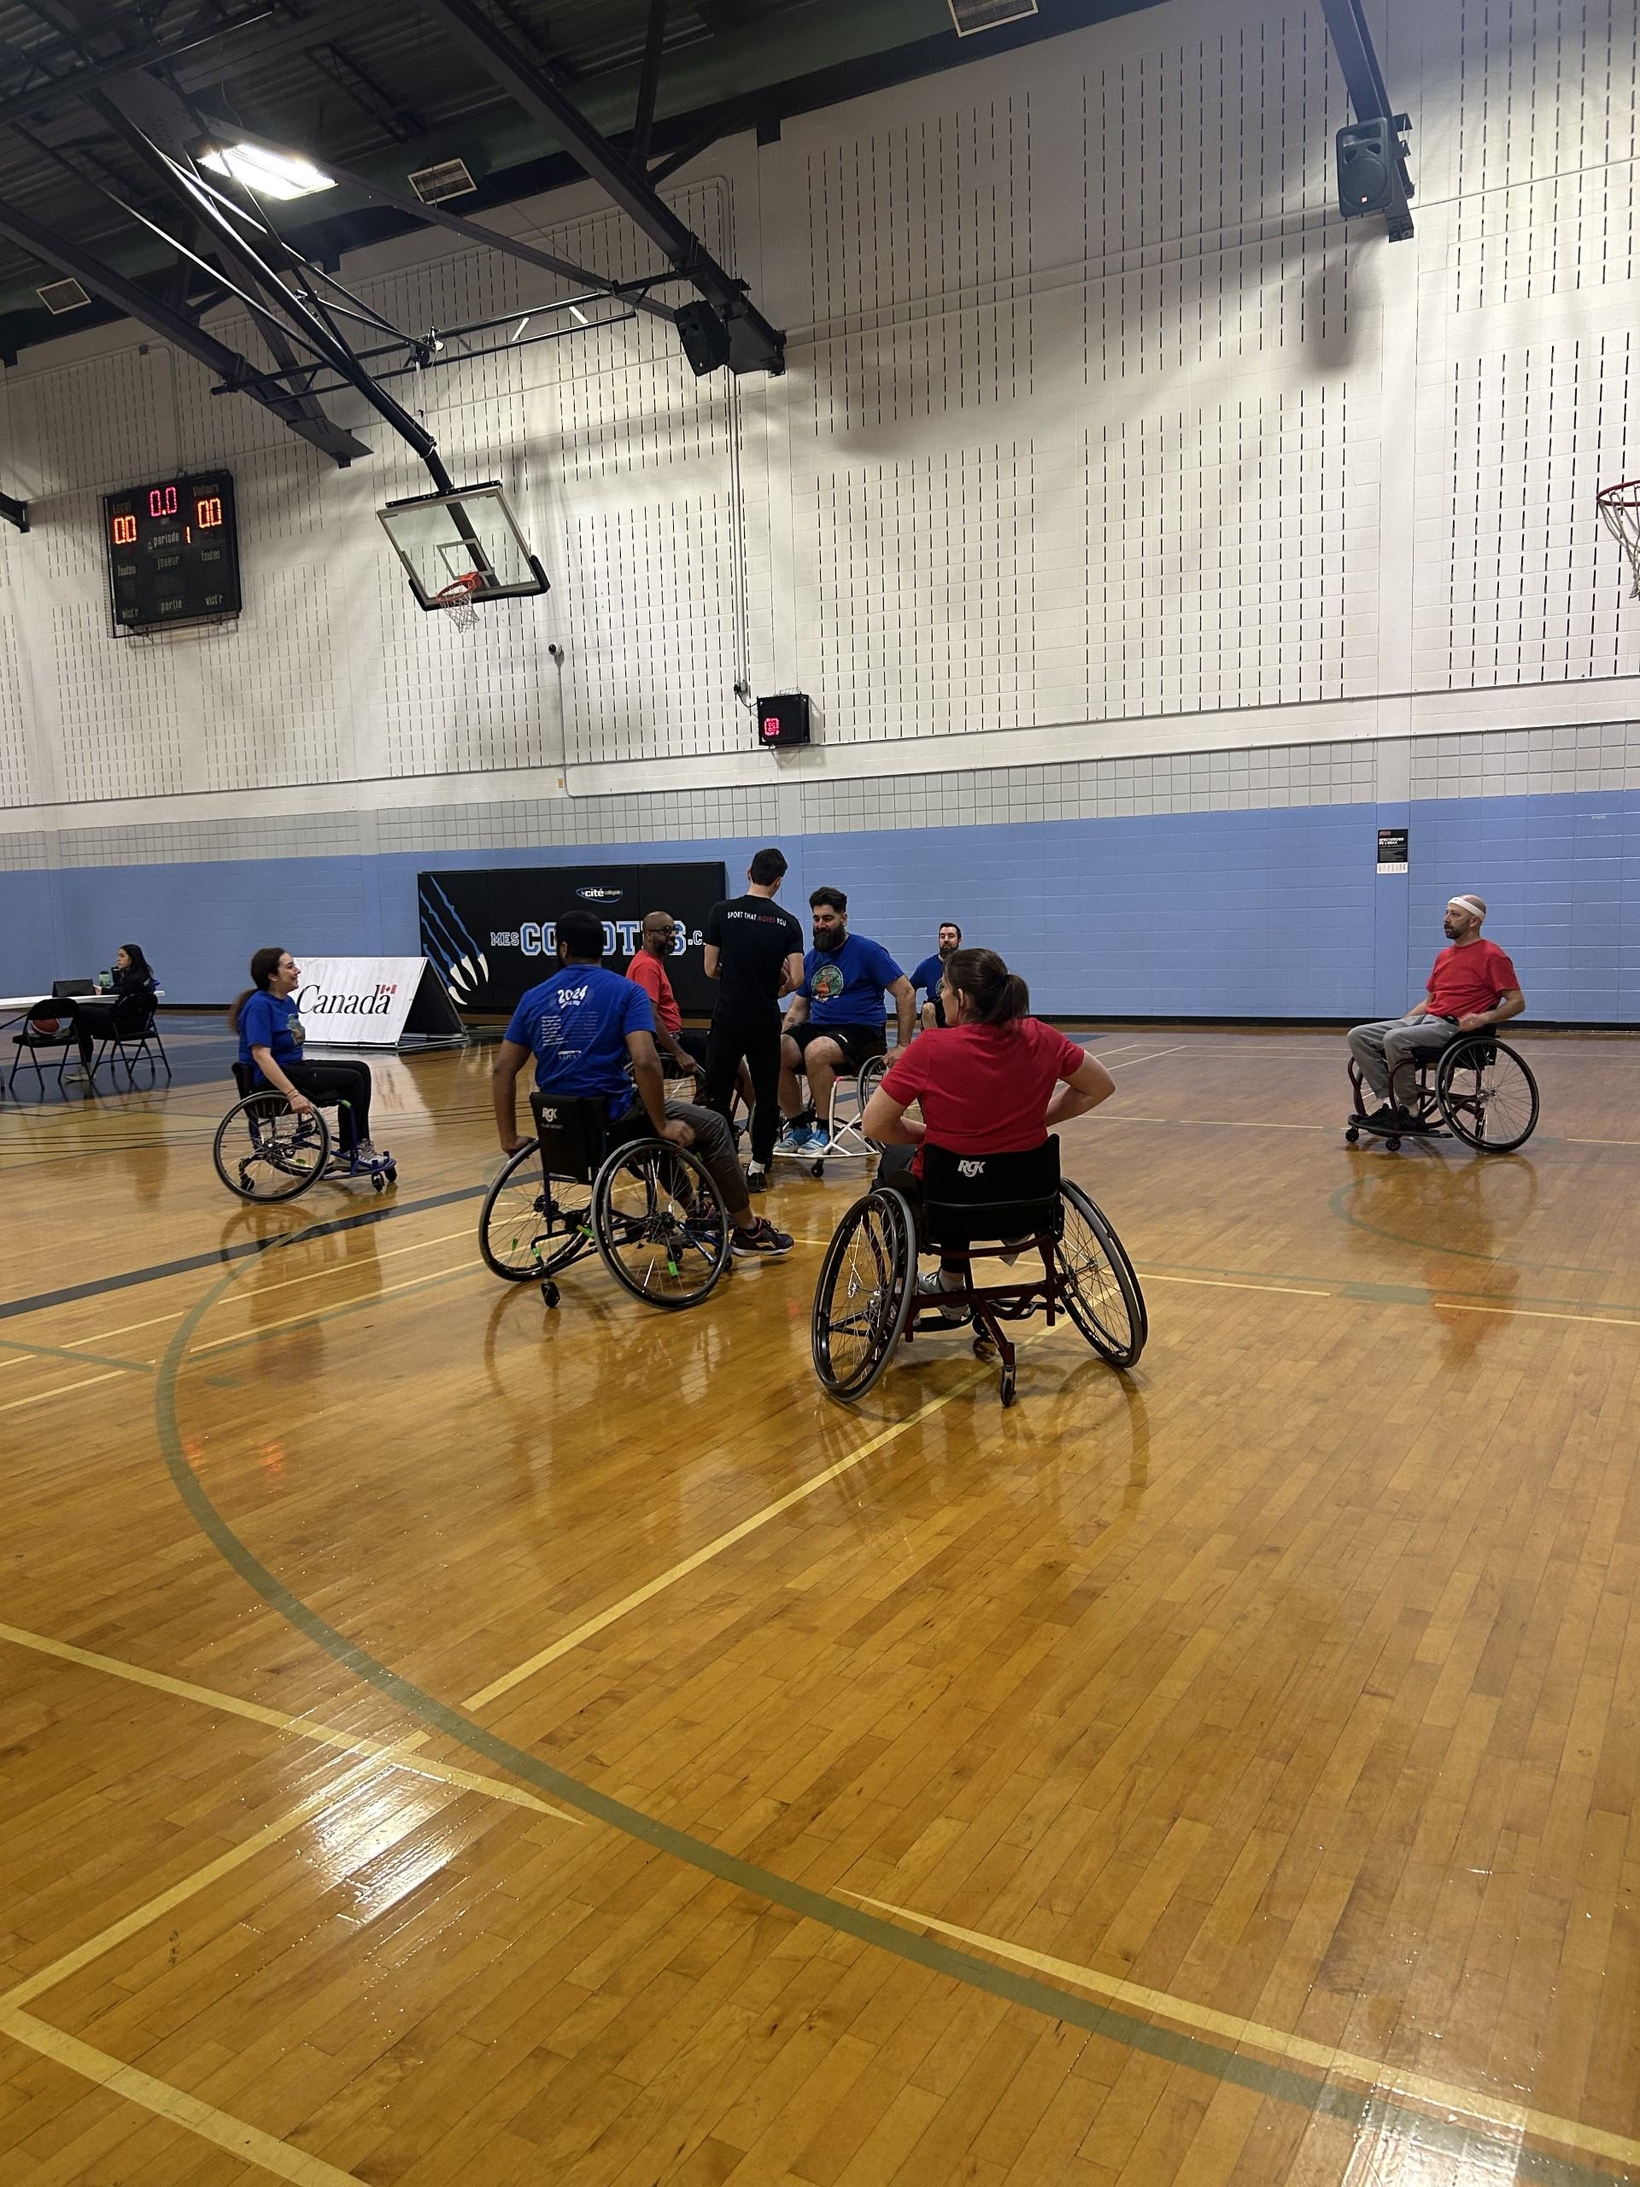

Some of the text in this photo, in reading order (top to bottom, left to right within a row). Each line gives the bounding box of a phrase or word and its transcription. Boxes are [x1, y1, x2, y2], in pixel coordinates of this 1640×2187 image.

[150, 486, 177, 517] 0.0
[198, 498, 222, 529] 00
[114, 515, 137, 545] 00
[297, 984, 390, 1015] Canada
[557, 985, 588, 1004] 2024
